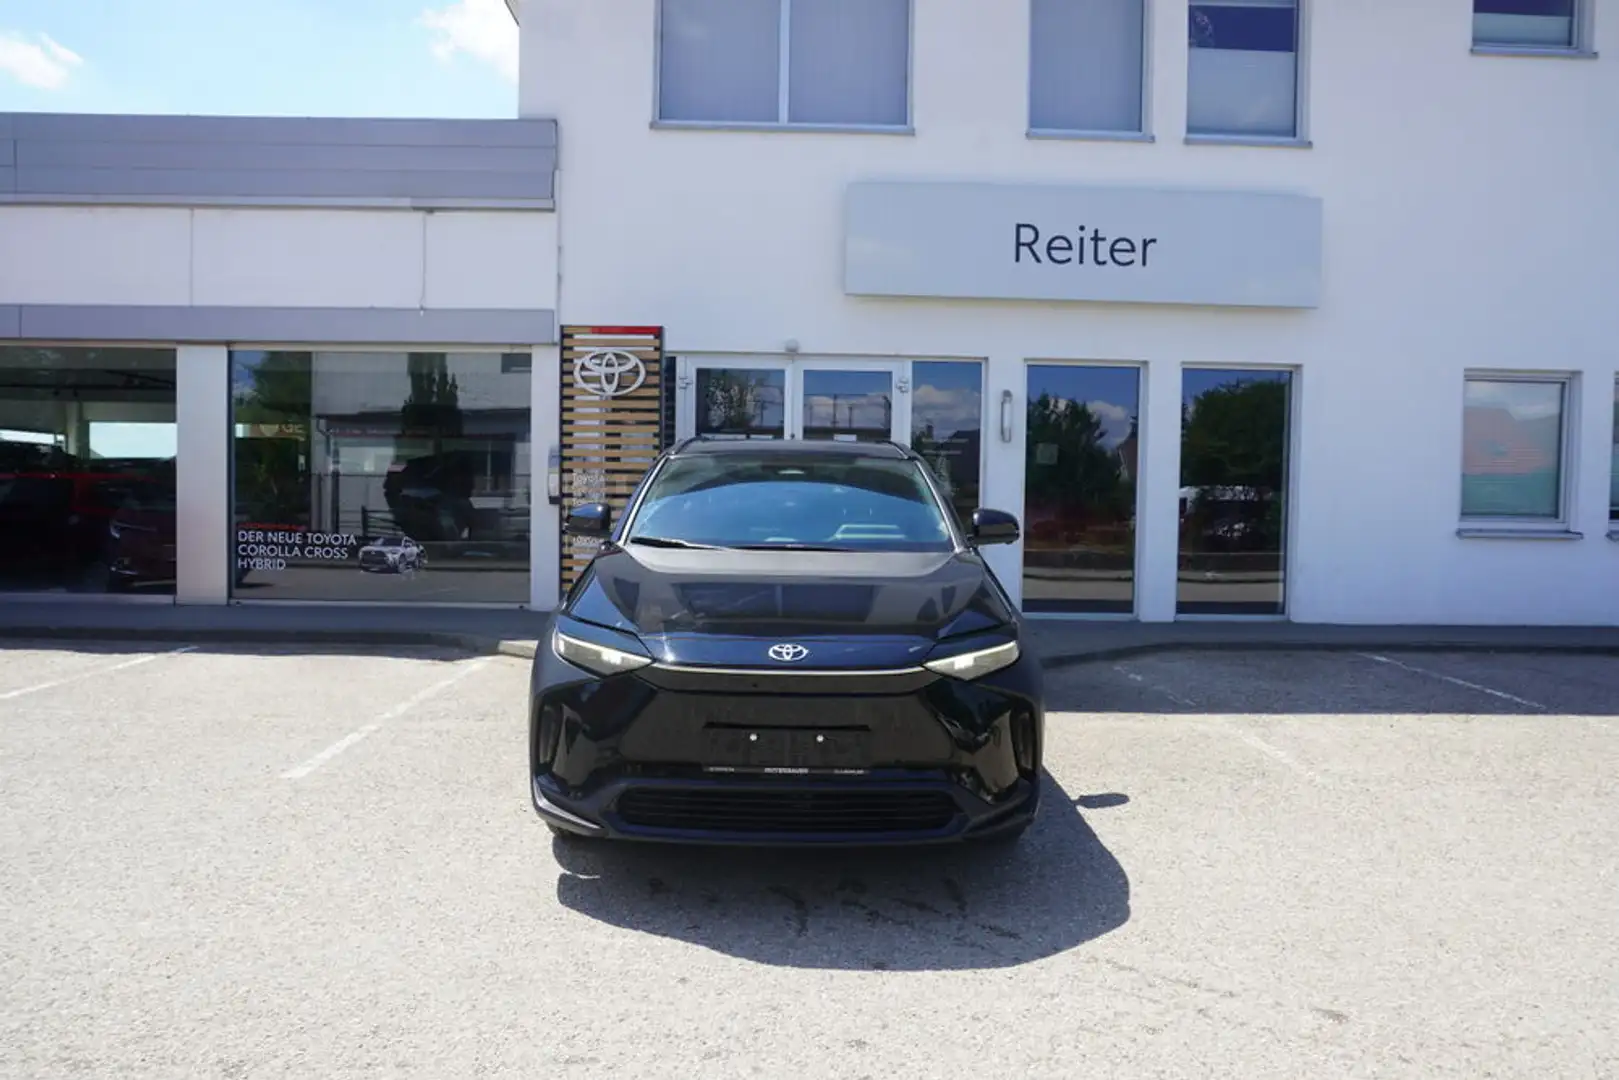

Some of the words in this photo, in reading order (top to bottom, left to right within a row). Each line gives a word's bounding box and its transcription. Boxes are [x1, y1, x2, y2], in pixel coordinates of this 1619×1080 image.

[1015, 223, 1157, 267] Reiter
[237, 530, 264, 543] DER
[267, 531, 303, 544] NEUE
[306, 533, 357, 545] TOYOTA
[237, 544, 301, 557] COROLLA
[304, 546, 349, 559] CROSS
[237, 557, 287, 570] HYBRID
